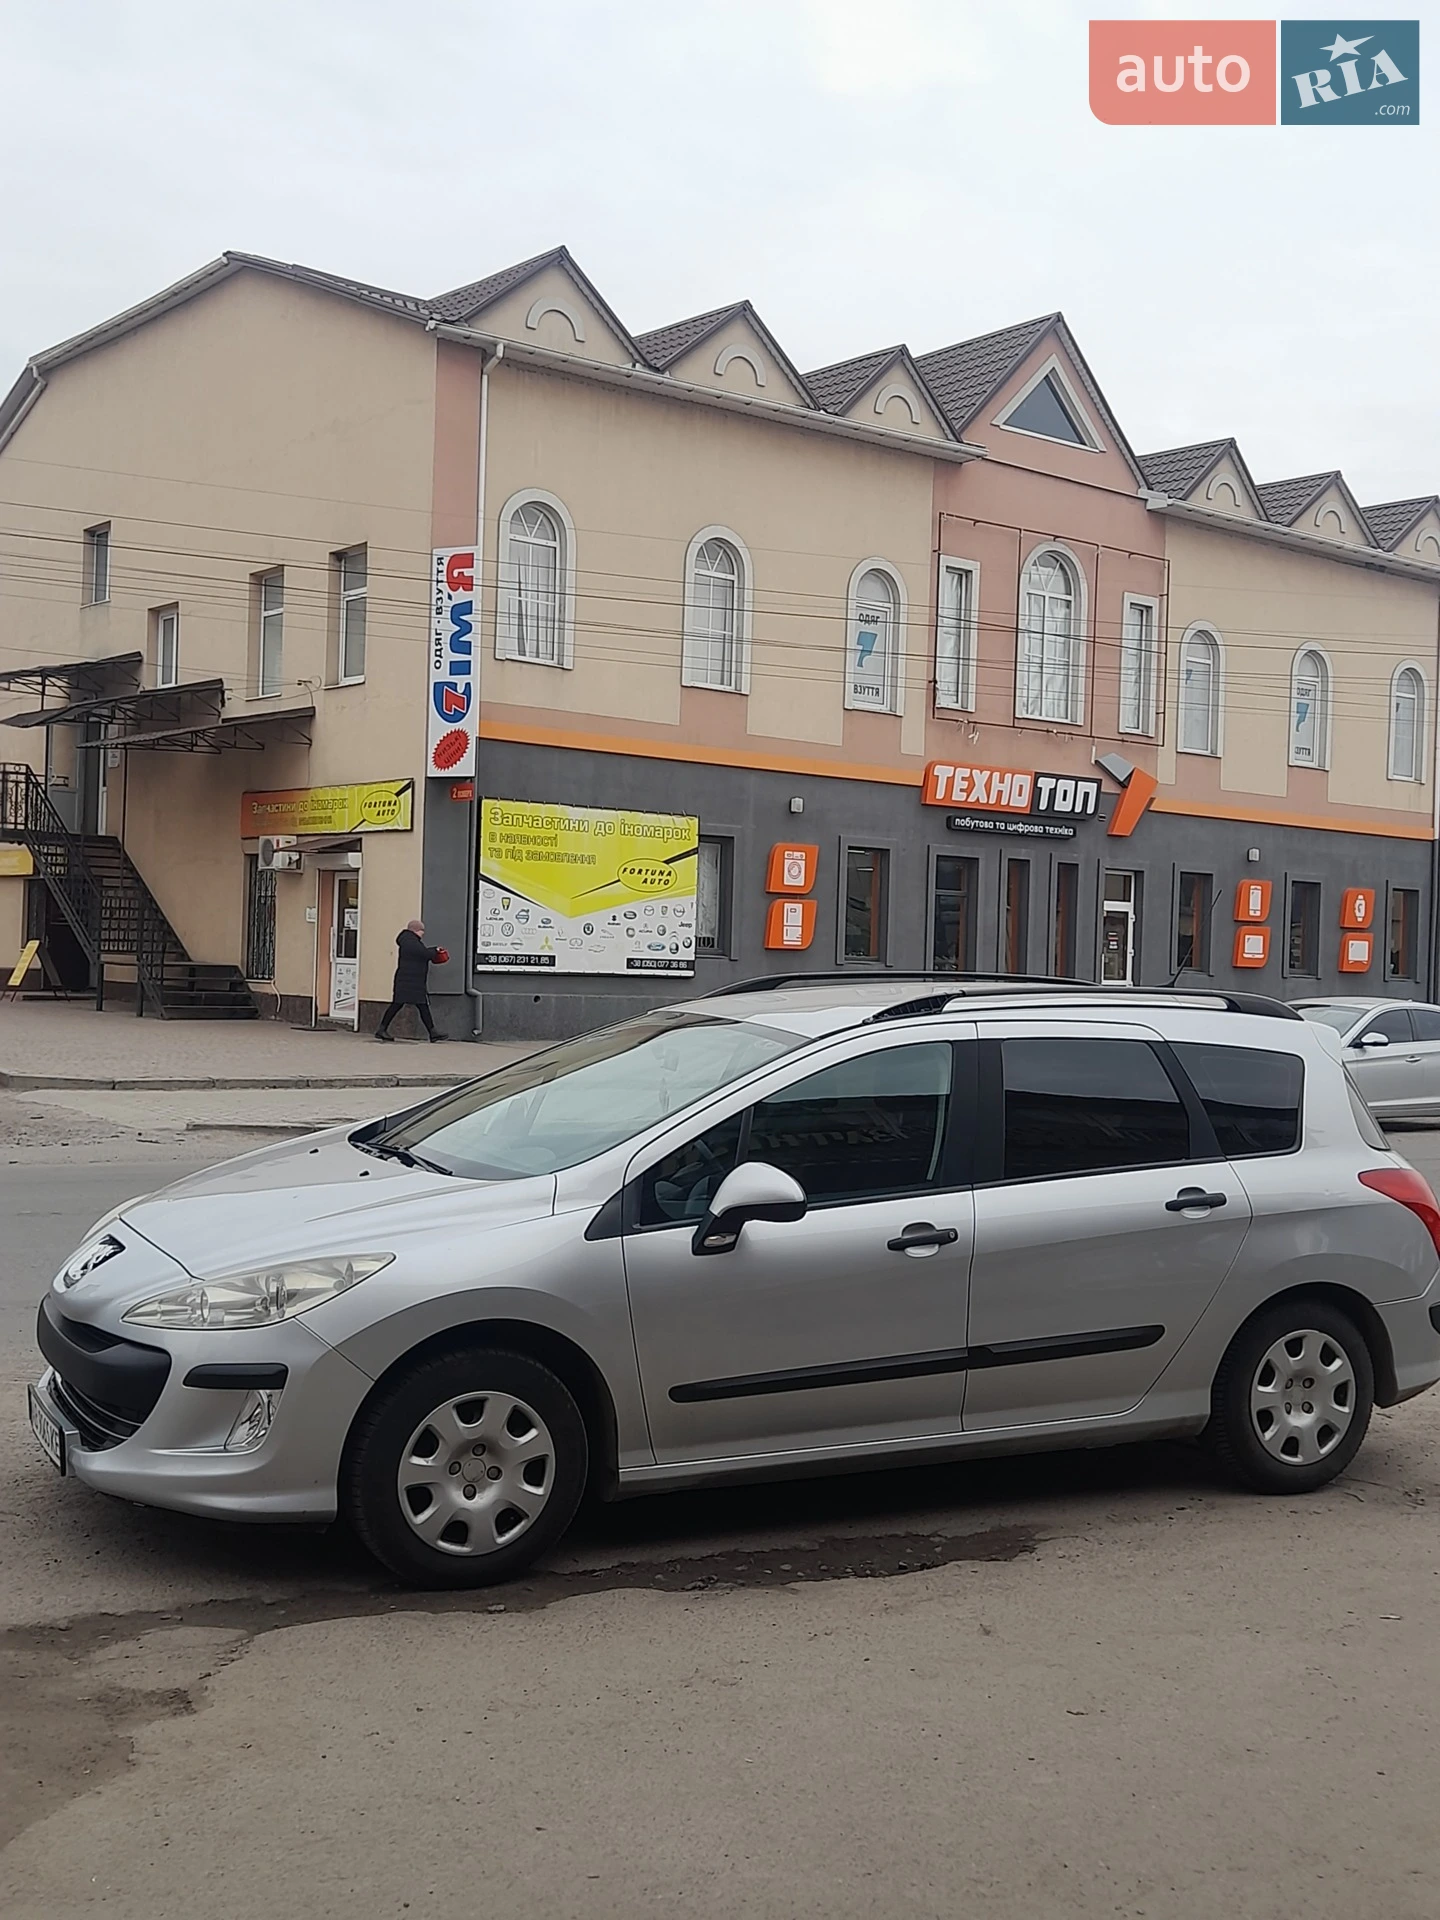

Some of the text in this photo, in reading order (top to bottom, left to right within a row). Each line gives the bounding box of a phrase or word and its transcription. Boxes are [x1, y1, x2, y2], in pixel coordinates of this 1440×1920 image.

[434, 557, 444, 670] ОДЯГ ВЗУТТЯ
[859, 613, 880, 626] ОДЯГ
[853, 684, 880, 697] ВЗУТТЯ
[933, 764, 1099, 816] ТЕХНО ТОП
[299, 801, 308, 812] до
[364, 800, 397, 808] FORTUNA
[376, 809, 396, 817] AUTO
[490, 807, 692, 843] Запчастини до іномарок
[955, 817, 1074, 836] побутова та цифрова техніка
[499, 833, 558, 847] наявності
[488, 846, 596, 865] та під замовлення
[622, 867, 672, 877] FORTUNA
[642, 878, 670, 886] AUTO
[516, 956, 529, 964] 231
[530, 956, 538, 964] 21
